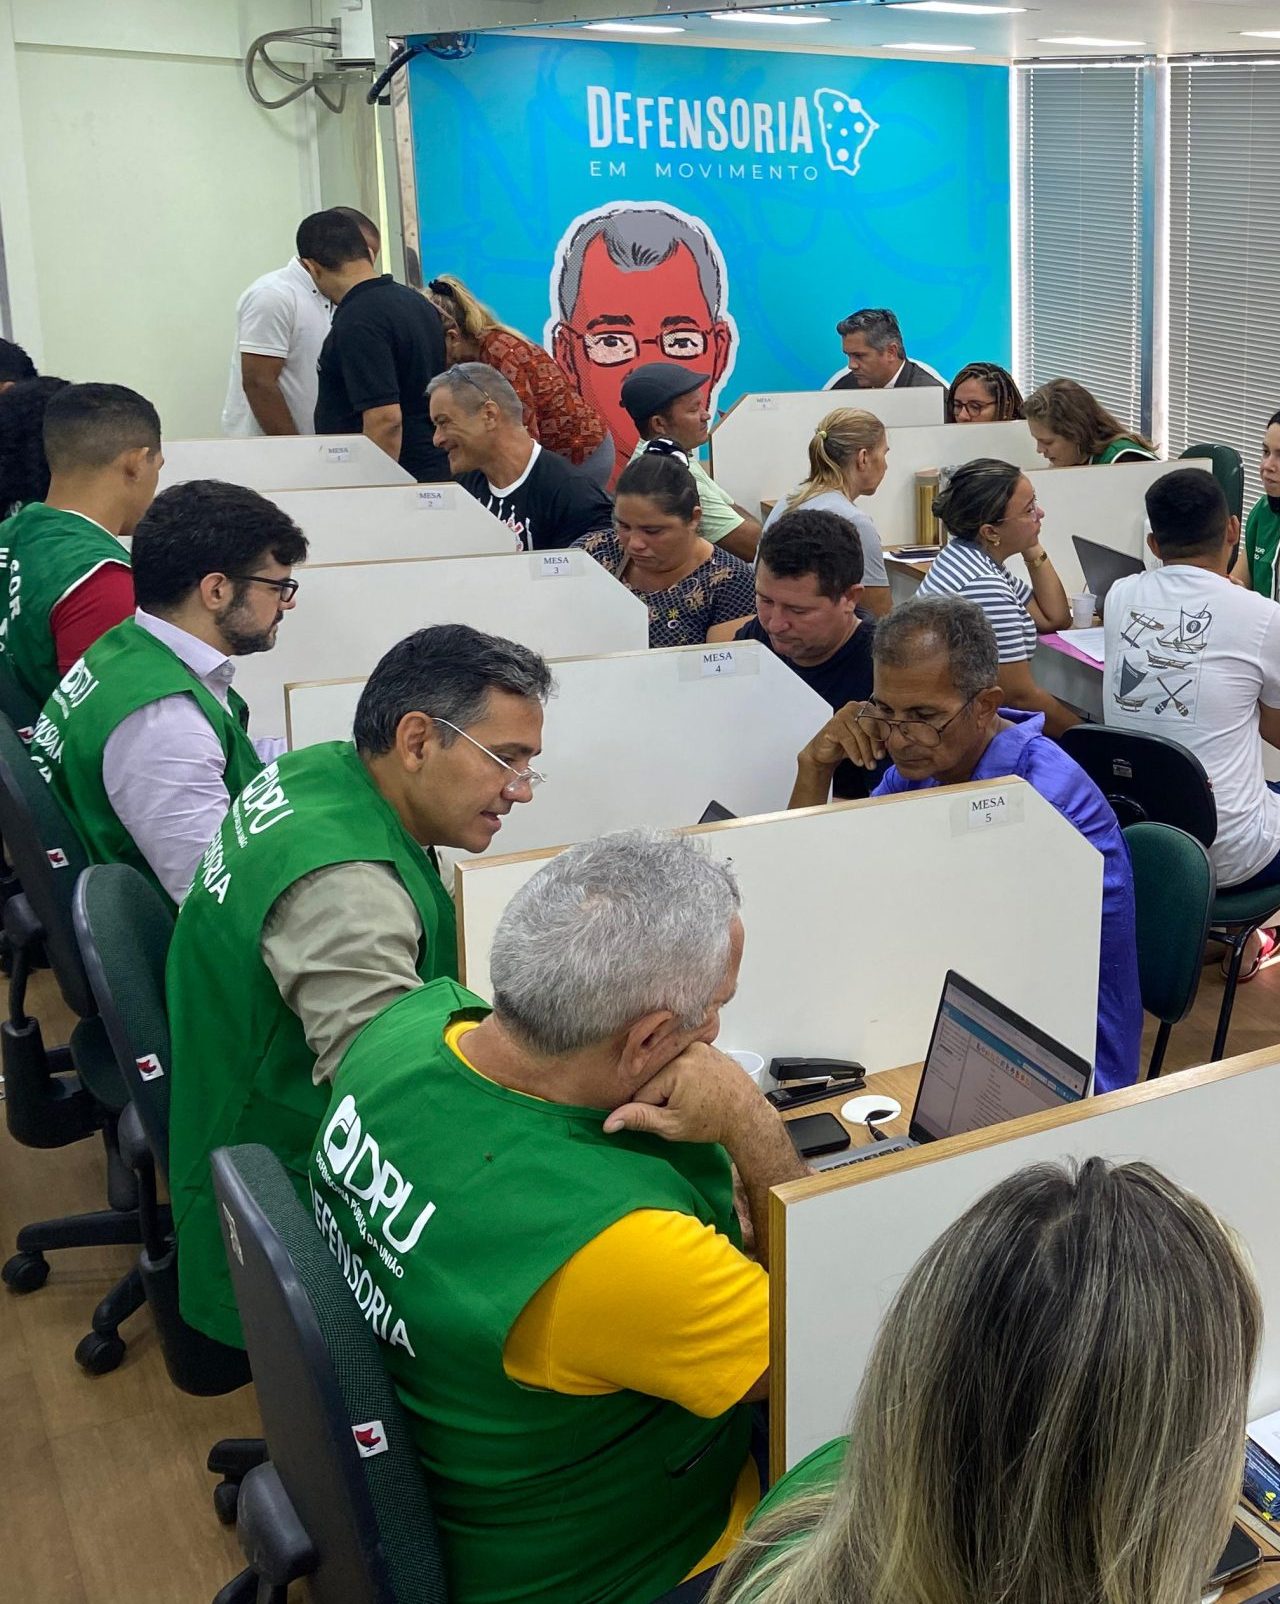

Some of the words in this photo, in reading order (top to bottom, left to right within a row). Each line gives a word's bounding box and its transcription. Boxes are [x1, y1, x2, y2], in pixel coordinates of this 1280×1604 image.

[586, 85, 814, 154] DEFENSORIA
[590, 161, 626, 177] EM
[655, 162, 819, 181] MOVIMENTO
[418, 492, 442, 500] MESA
[543, 556, 570, 565] MESA
[554, 566, 559, 574] 3
[703, 651, 733, 663] MESA
[715, 665, 722, 673] 4
[971, 796, 1006, 811] MESA
[985, 812, 992, 823] 5
[344, 1133, 437, 1254] DPU
[316, 1150, 350, 1205] DEFENSORIA
[350, 1198, 367, 1240] PÚBLICA
[367, 1233, 379, 1251] DA
[379, 1244, 404, 1279] UNIÃO
[310, 1178, 416, 1358] EFENSORIA
